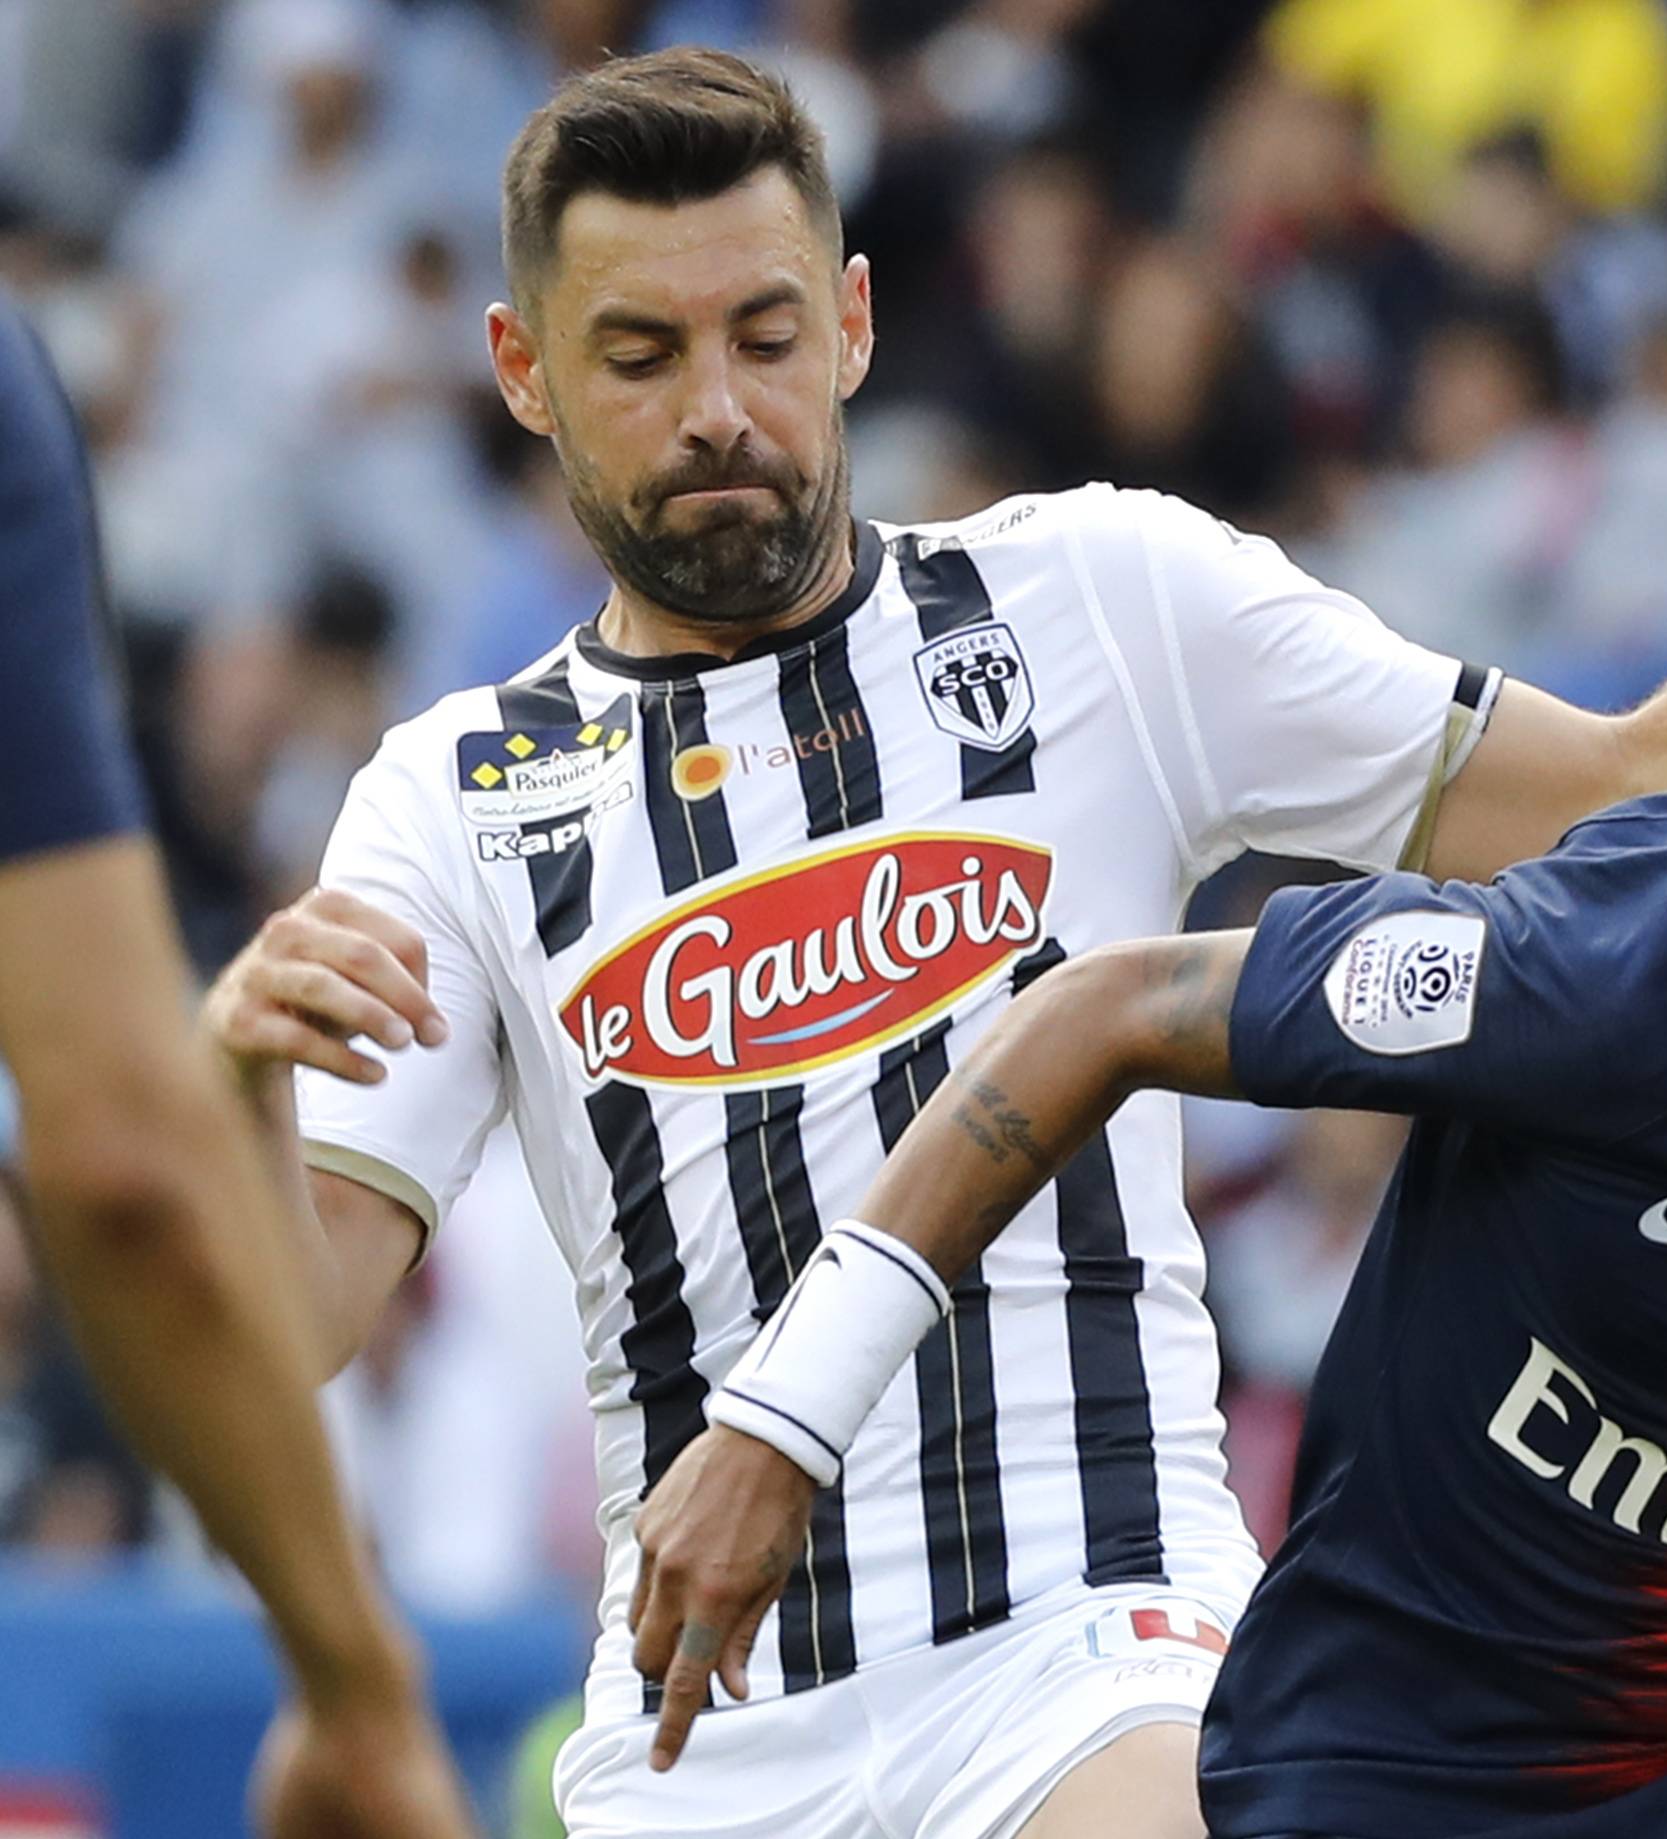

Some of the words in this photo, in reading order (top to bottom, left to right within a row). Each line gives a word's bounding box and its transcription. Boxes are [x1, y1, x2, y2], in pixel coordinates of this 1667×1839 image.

[932, 632, 1001, 663] ANGERS
[938, 659, 1009, 696] SCO
[737, 708, 865, 776] l'atoll
[515, 760, 599, 792] Pasquier
[582, 994, 632, 1071] le
[642, 853, 1037, 1067] Gaulois
[1355, 938, 1377, 1006] LIGUE
